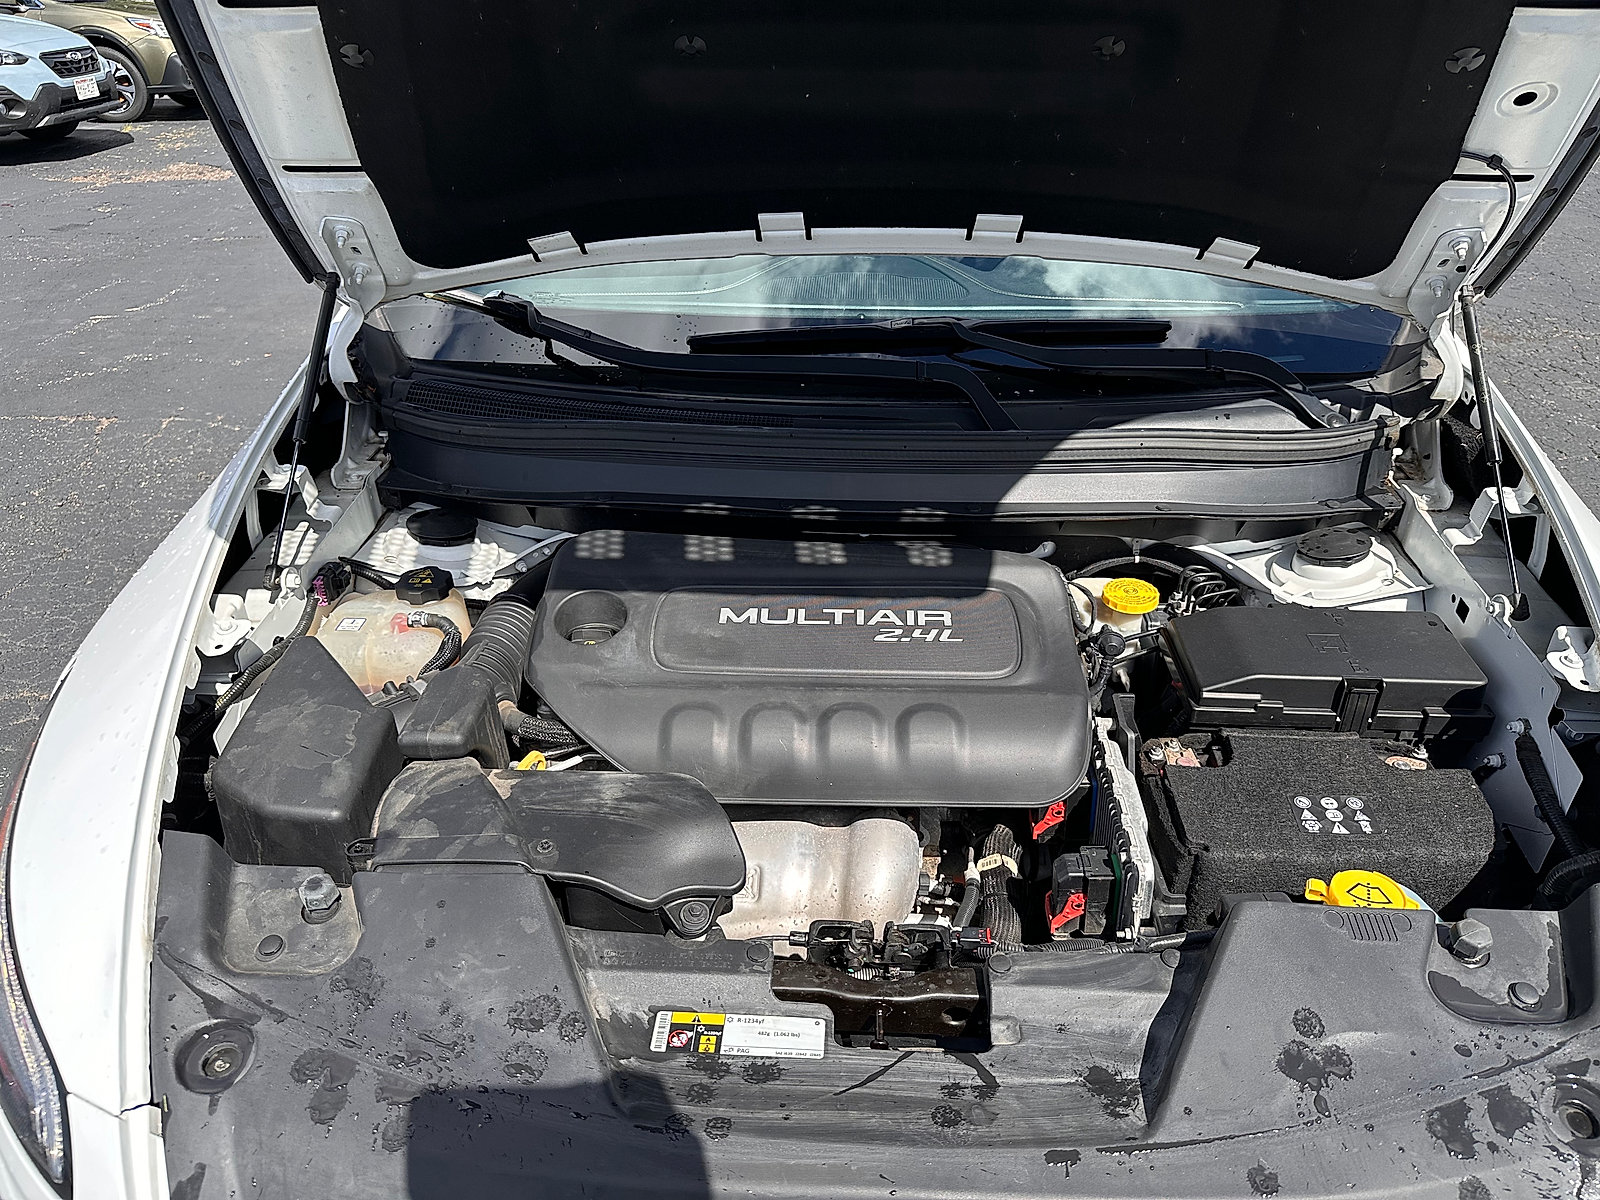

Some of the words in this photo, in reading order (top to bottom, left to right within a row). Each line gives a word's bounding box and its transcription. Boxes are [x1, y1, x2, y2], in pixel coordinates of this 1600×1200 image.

[718, 607, 953, 626] MULTIAIR
[874, 628, 964, 642] 2.4L
[737, 1017, 765, 1025] R-1234yf
